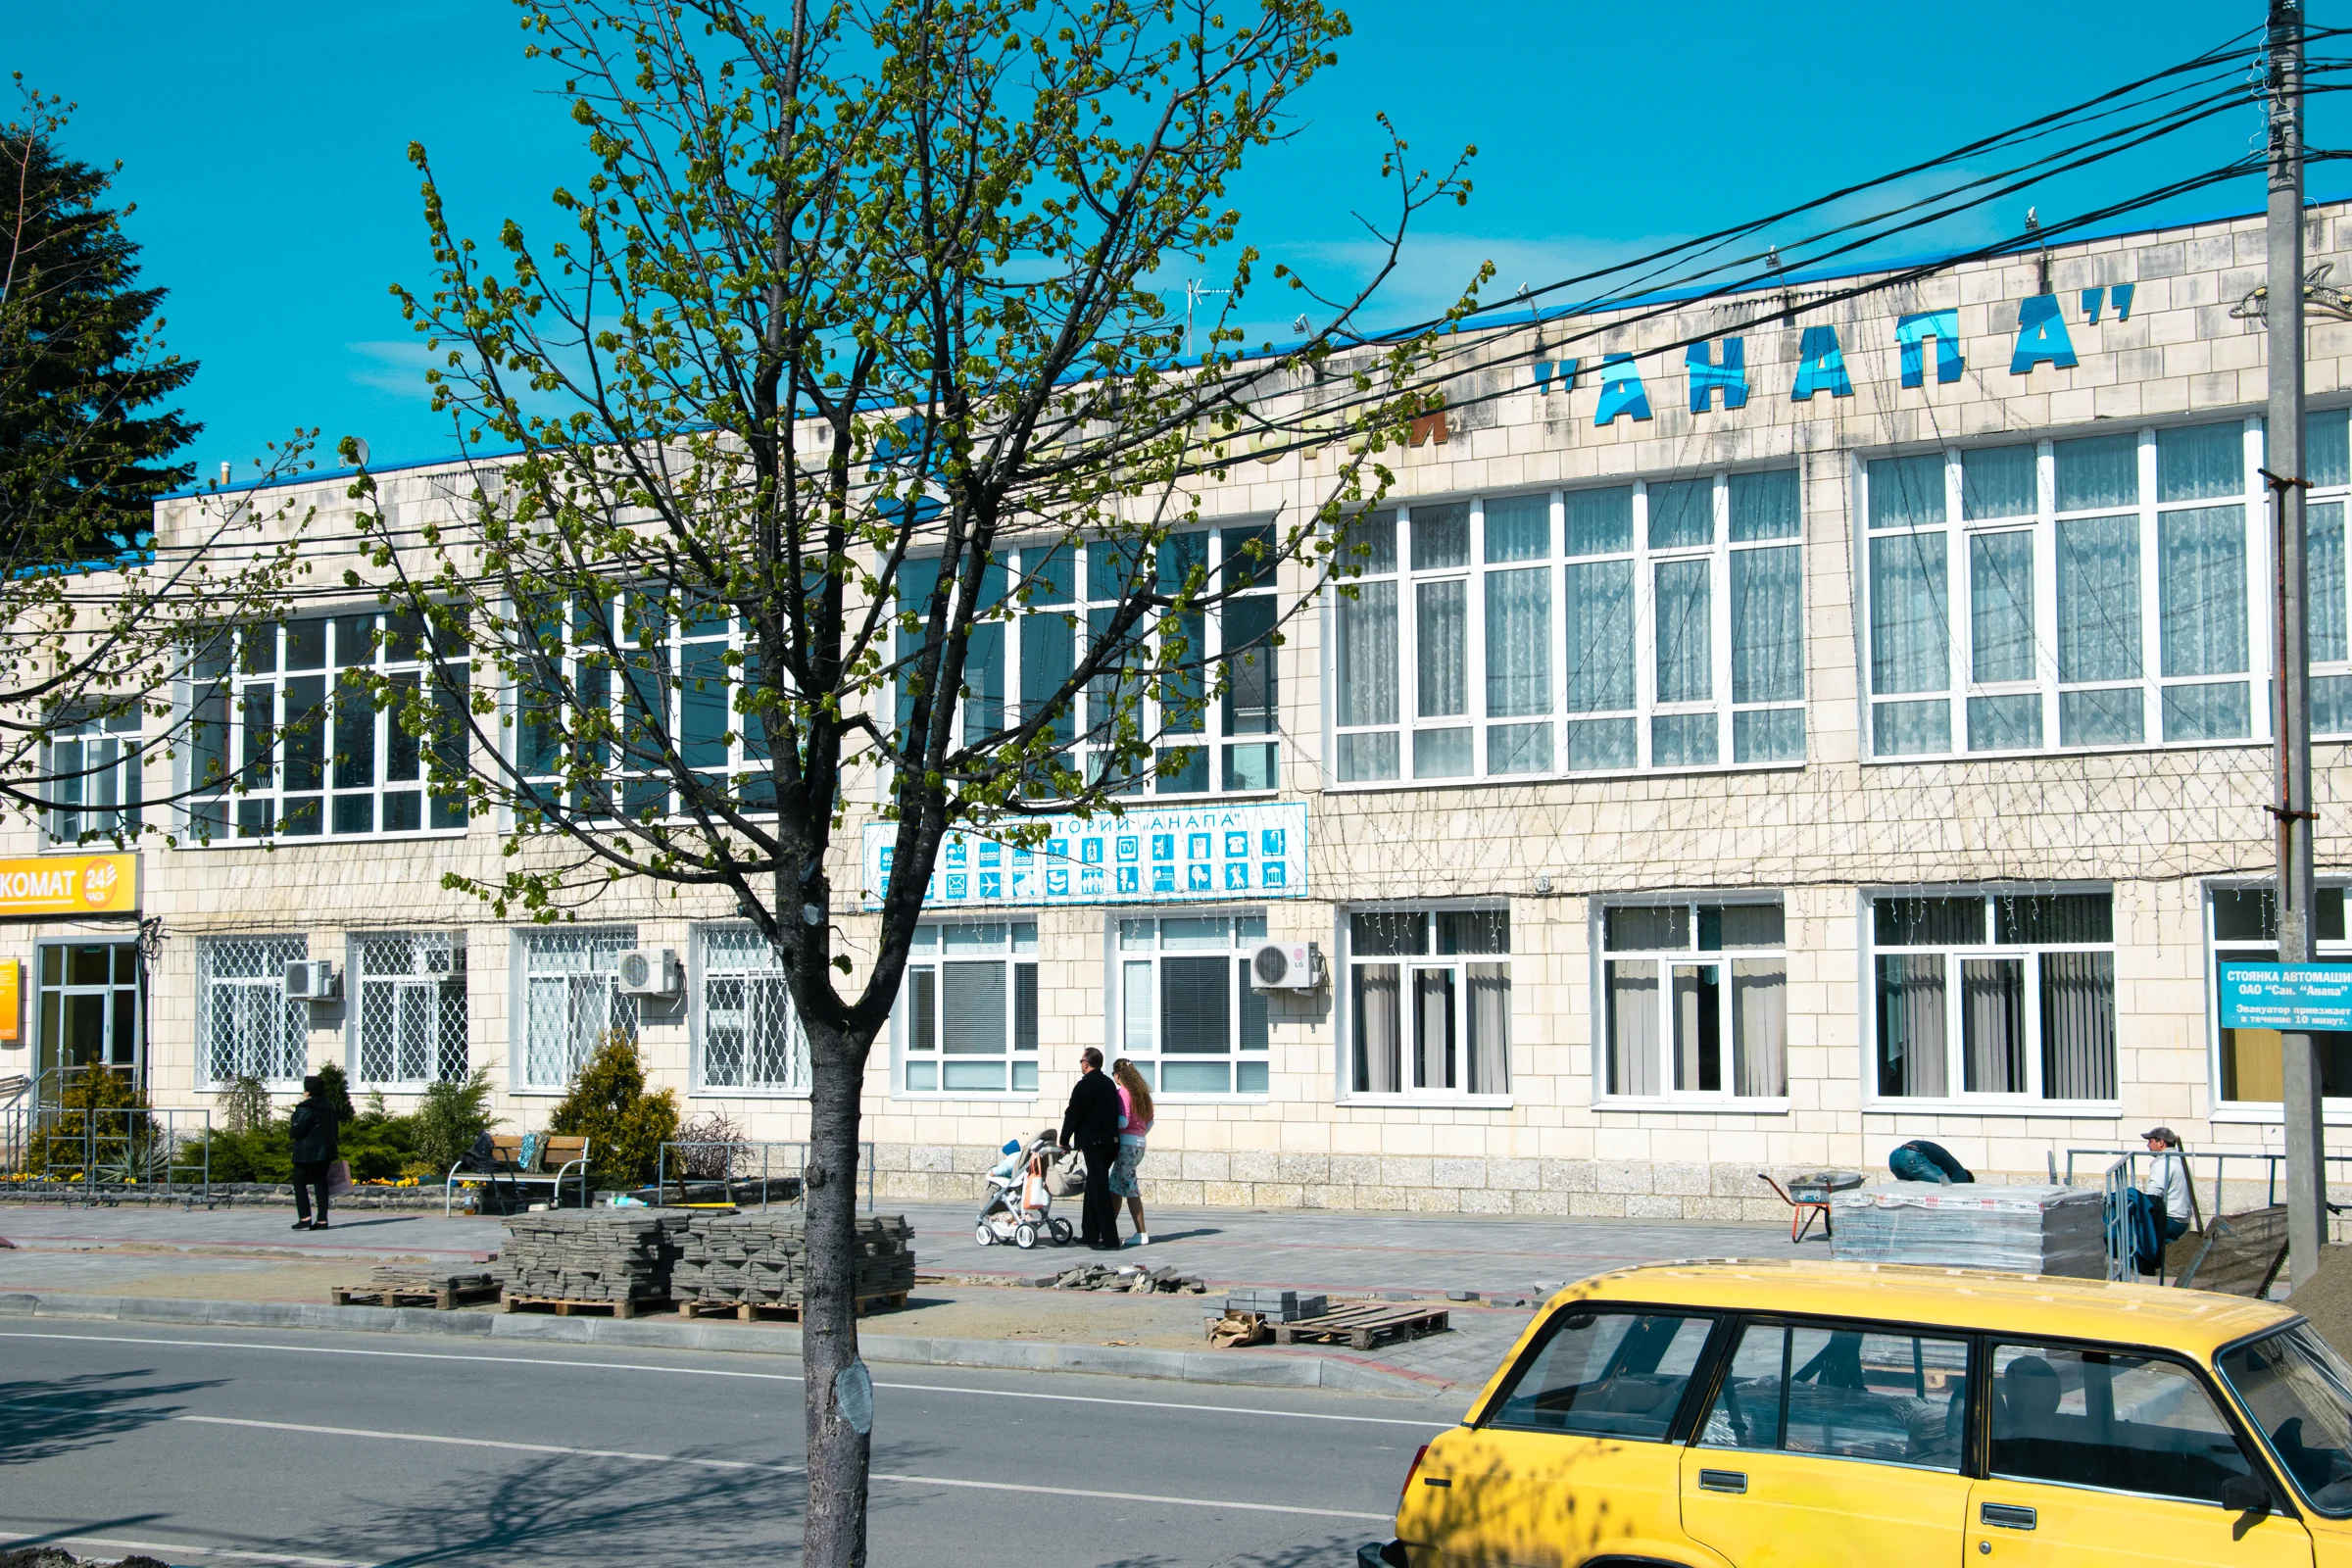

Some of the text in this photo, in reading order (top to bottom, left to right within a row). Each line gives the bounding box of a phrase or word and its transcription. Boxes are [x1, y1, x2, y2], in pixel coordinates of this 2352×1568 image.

[1028, 380, 1449, 489] САТОРИЙ
[1121, 843, 1133, 853] TV
[0, 869, 76, 898] КОМАТ
[85, 868, 105, 890] 24
[2227, 970, 2352, 983] СТОЯНКА АВТОМАШИ
[2238, 984, 2262, 995] ОАО
[2236, 1004, 2351, 1016] Эвакуатор приезжает
[2294, 1015, 2309, 1024] 10
[2311, 1017, 2348, 1027] минут.
